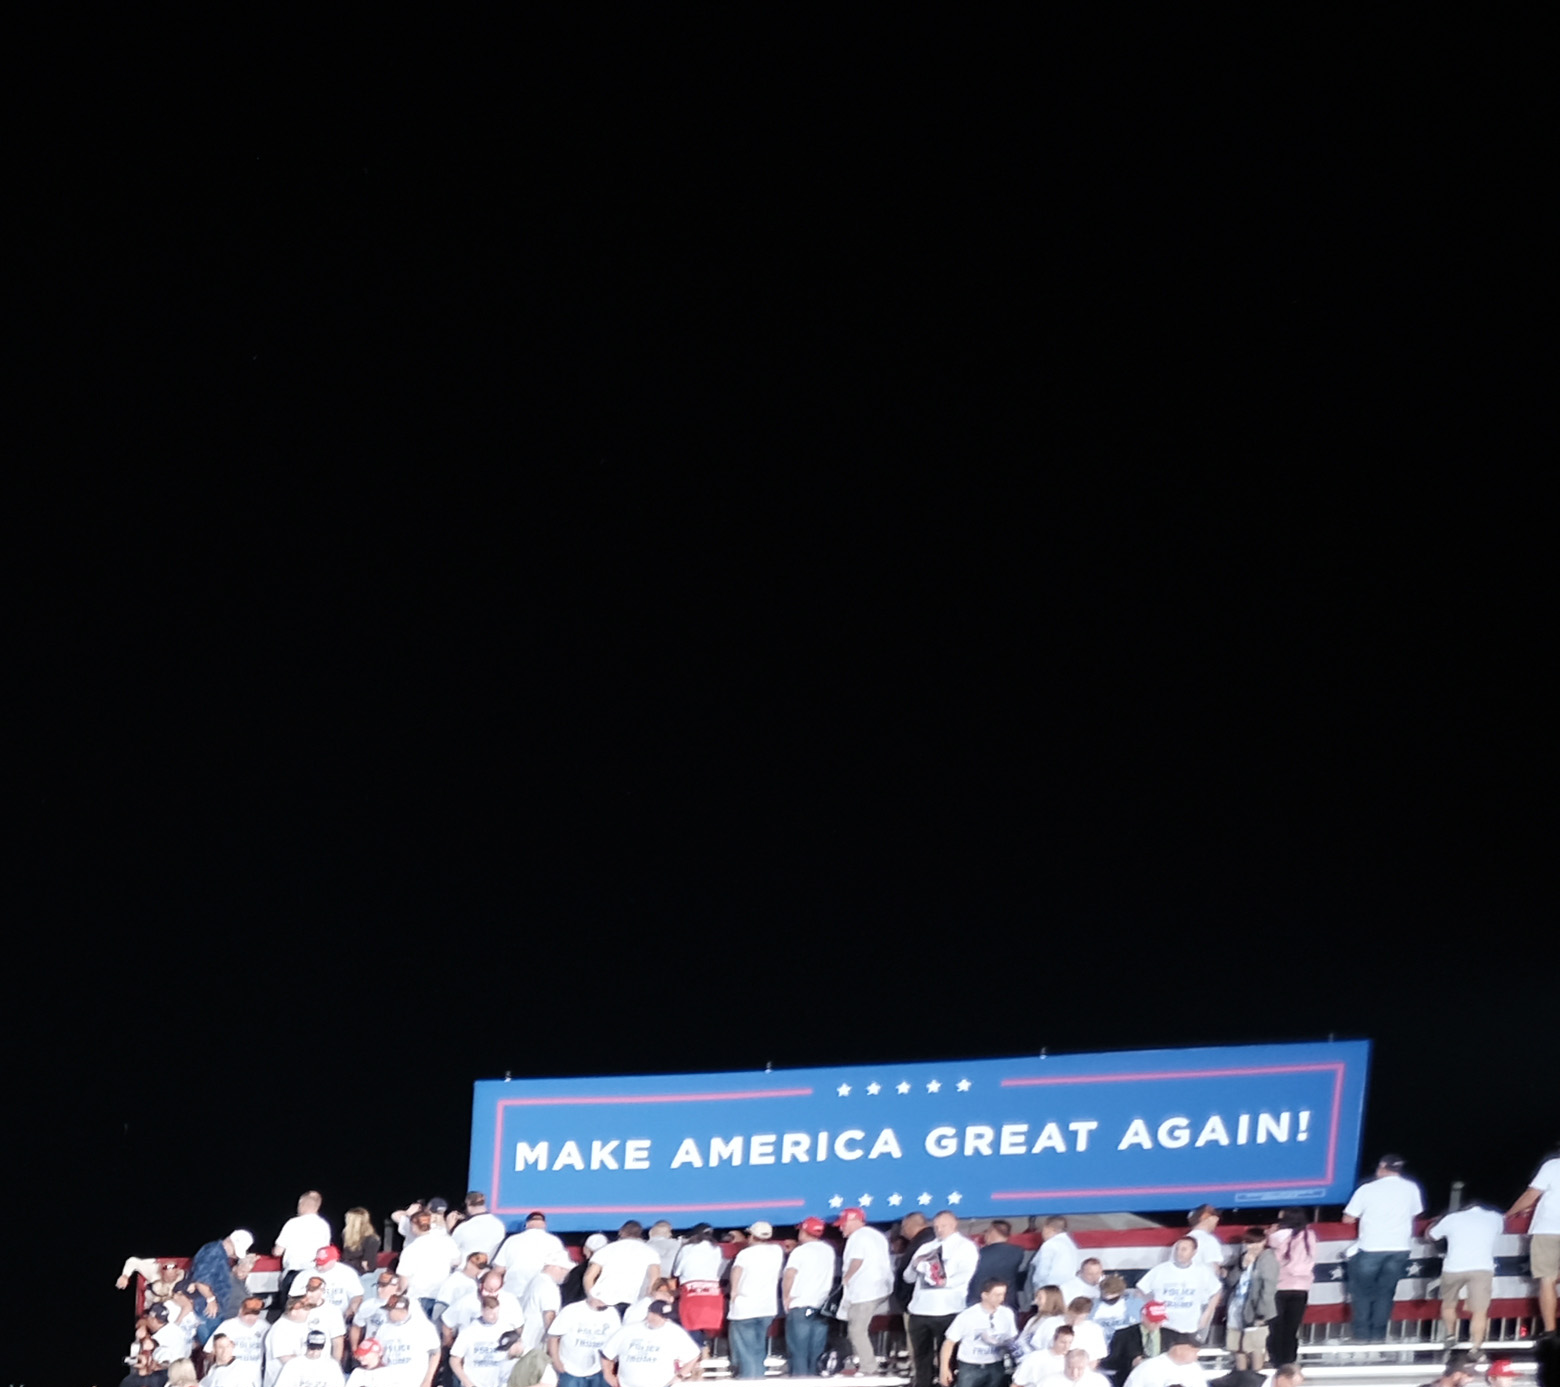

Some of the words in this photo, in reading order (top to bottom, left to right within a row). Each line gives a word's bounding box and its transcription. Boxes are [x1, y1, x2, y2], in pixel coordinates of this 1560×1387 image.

[514, 1139, 652, 1172] MAKE
[670, 1128, 903, 1169] AMERICA
[924, 1122, 1099, 1158] GREAT
[1117, 1111, 1312, 1151] AGAIN!
